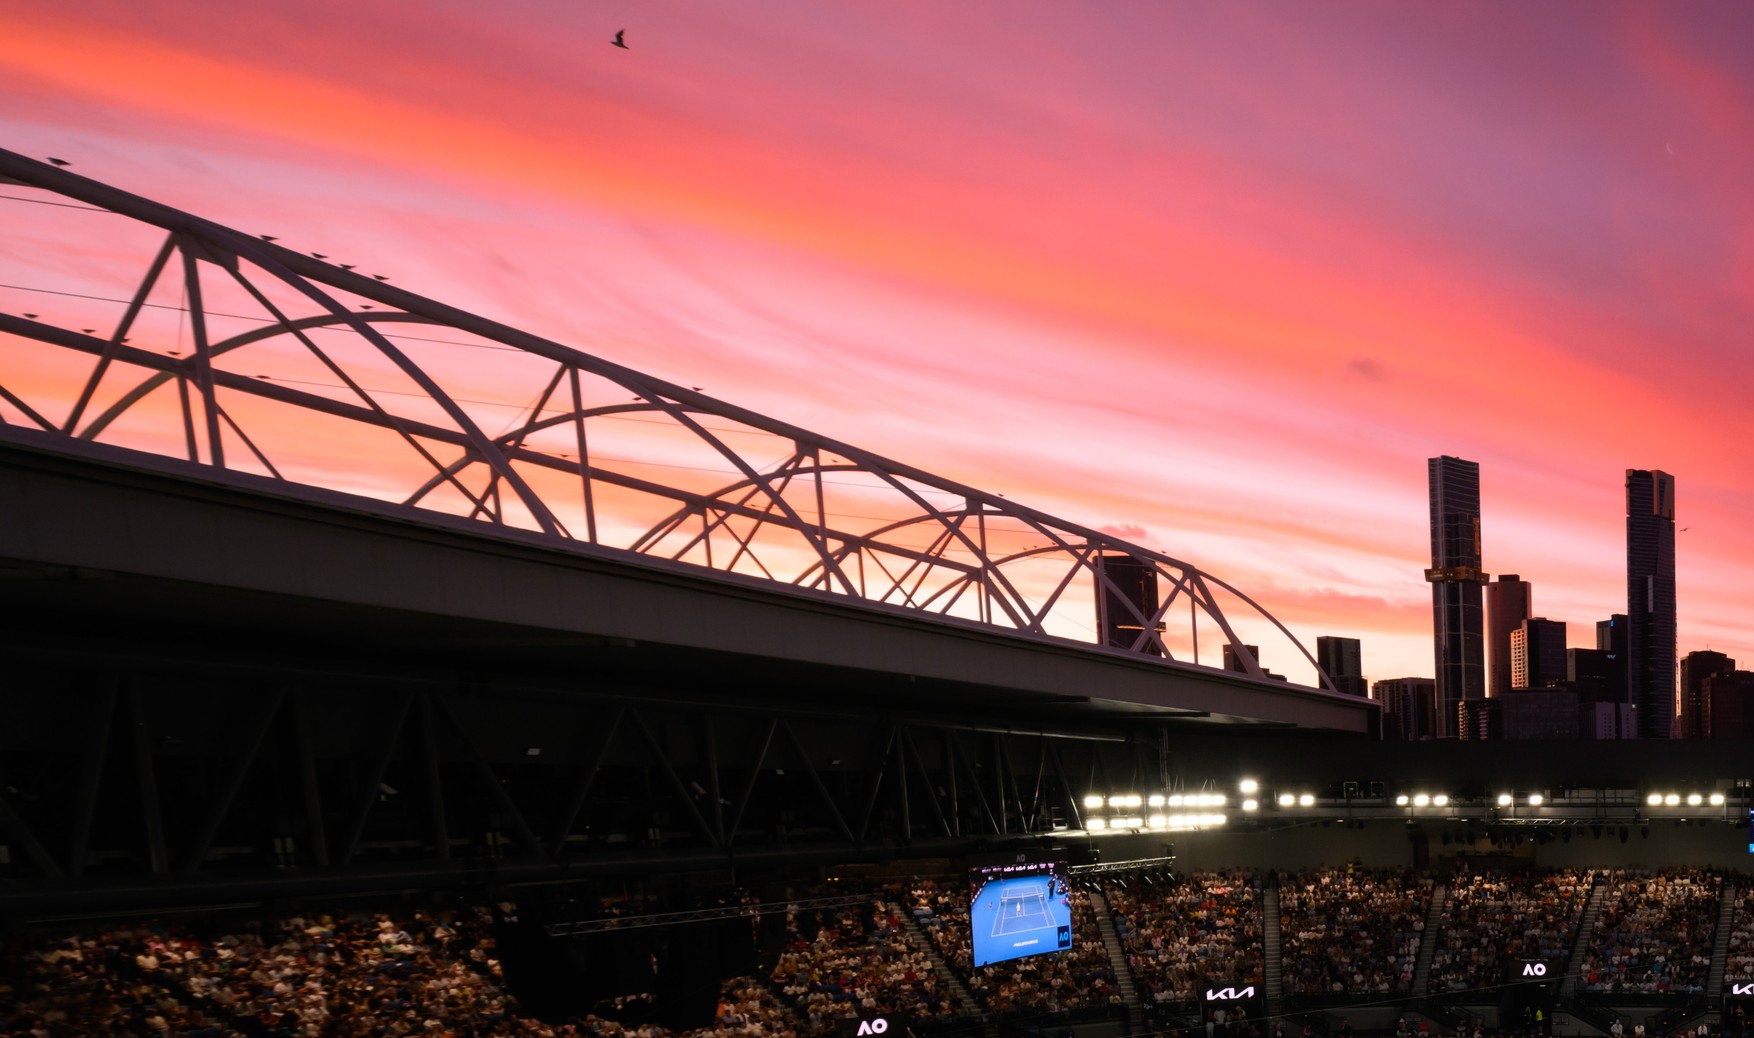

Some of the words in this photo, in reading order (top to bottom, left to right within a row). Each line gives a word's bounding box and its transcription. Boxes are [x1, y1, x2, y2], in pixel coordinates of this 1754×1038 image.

[1523, 963, 1547, 976] AO
[1206, 986, 1255, 1001] KIA
[857, 1018, 888, 1036] AO
